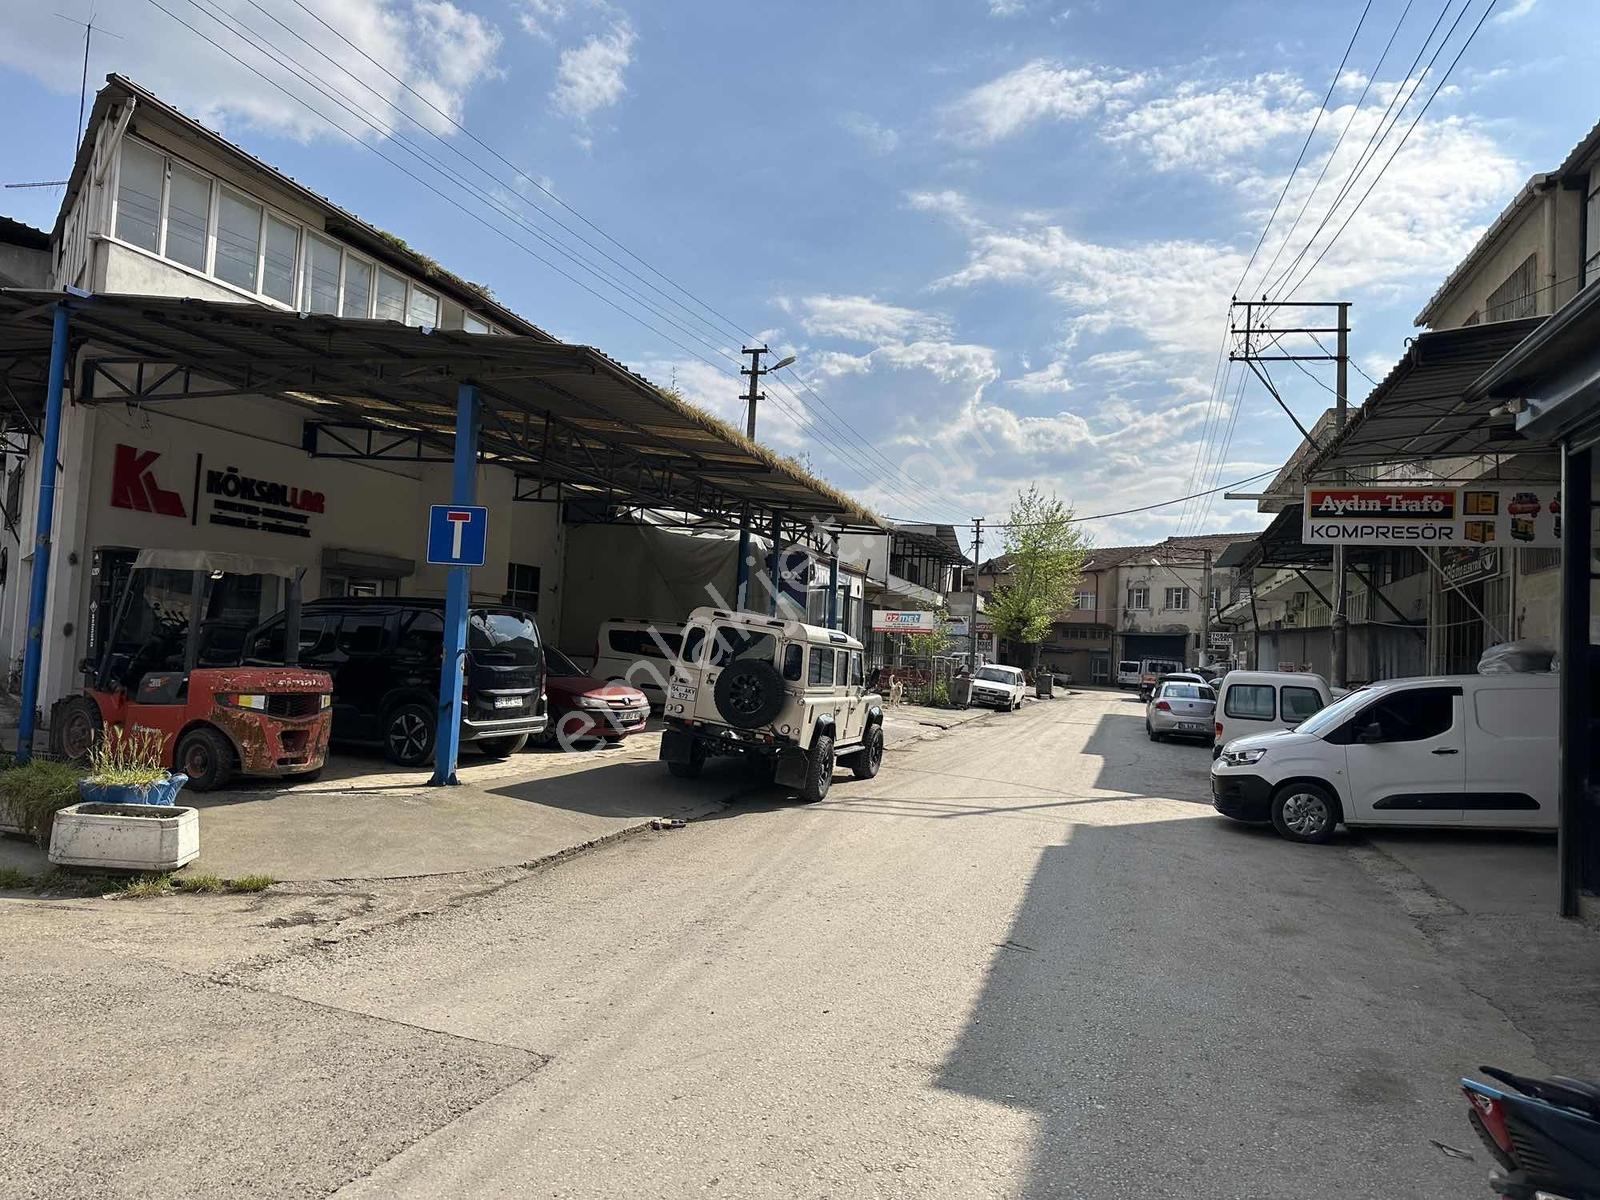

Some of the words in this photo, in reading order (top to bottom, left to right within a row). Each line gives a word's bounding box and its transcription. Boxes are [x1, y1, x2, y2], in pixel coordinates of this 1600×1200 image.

[1319, 495, 1382, 515] Aydın
[1386, 494, 1444, 512] Trafo
[1311, 523, 1454, 540] KOMPRESÖR
